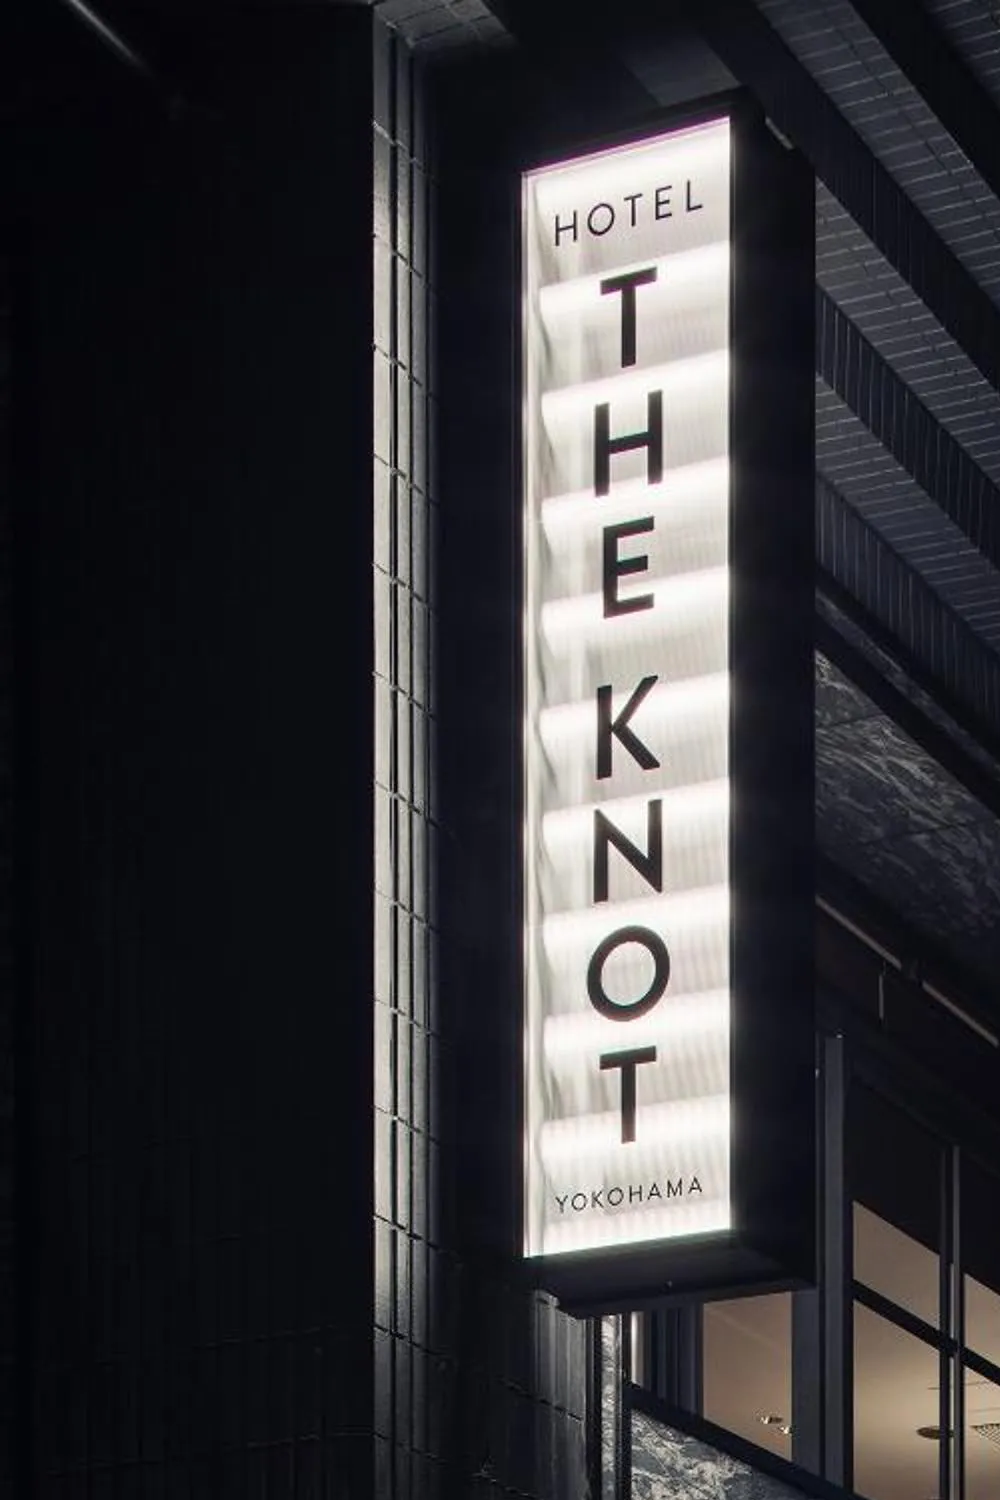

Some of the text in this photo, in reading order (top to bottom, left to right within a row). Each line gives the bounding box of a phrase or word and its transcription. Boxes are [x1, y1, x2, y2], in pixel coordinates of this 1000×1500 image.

[553, 179, 703, 247] HOTEL
[586, 266, 670, 1143] THE KNOT
[554, 1175, 703, 1213] YOKOHAMA
